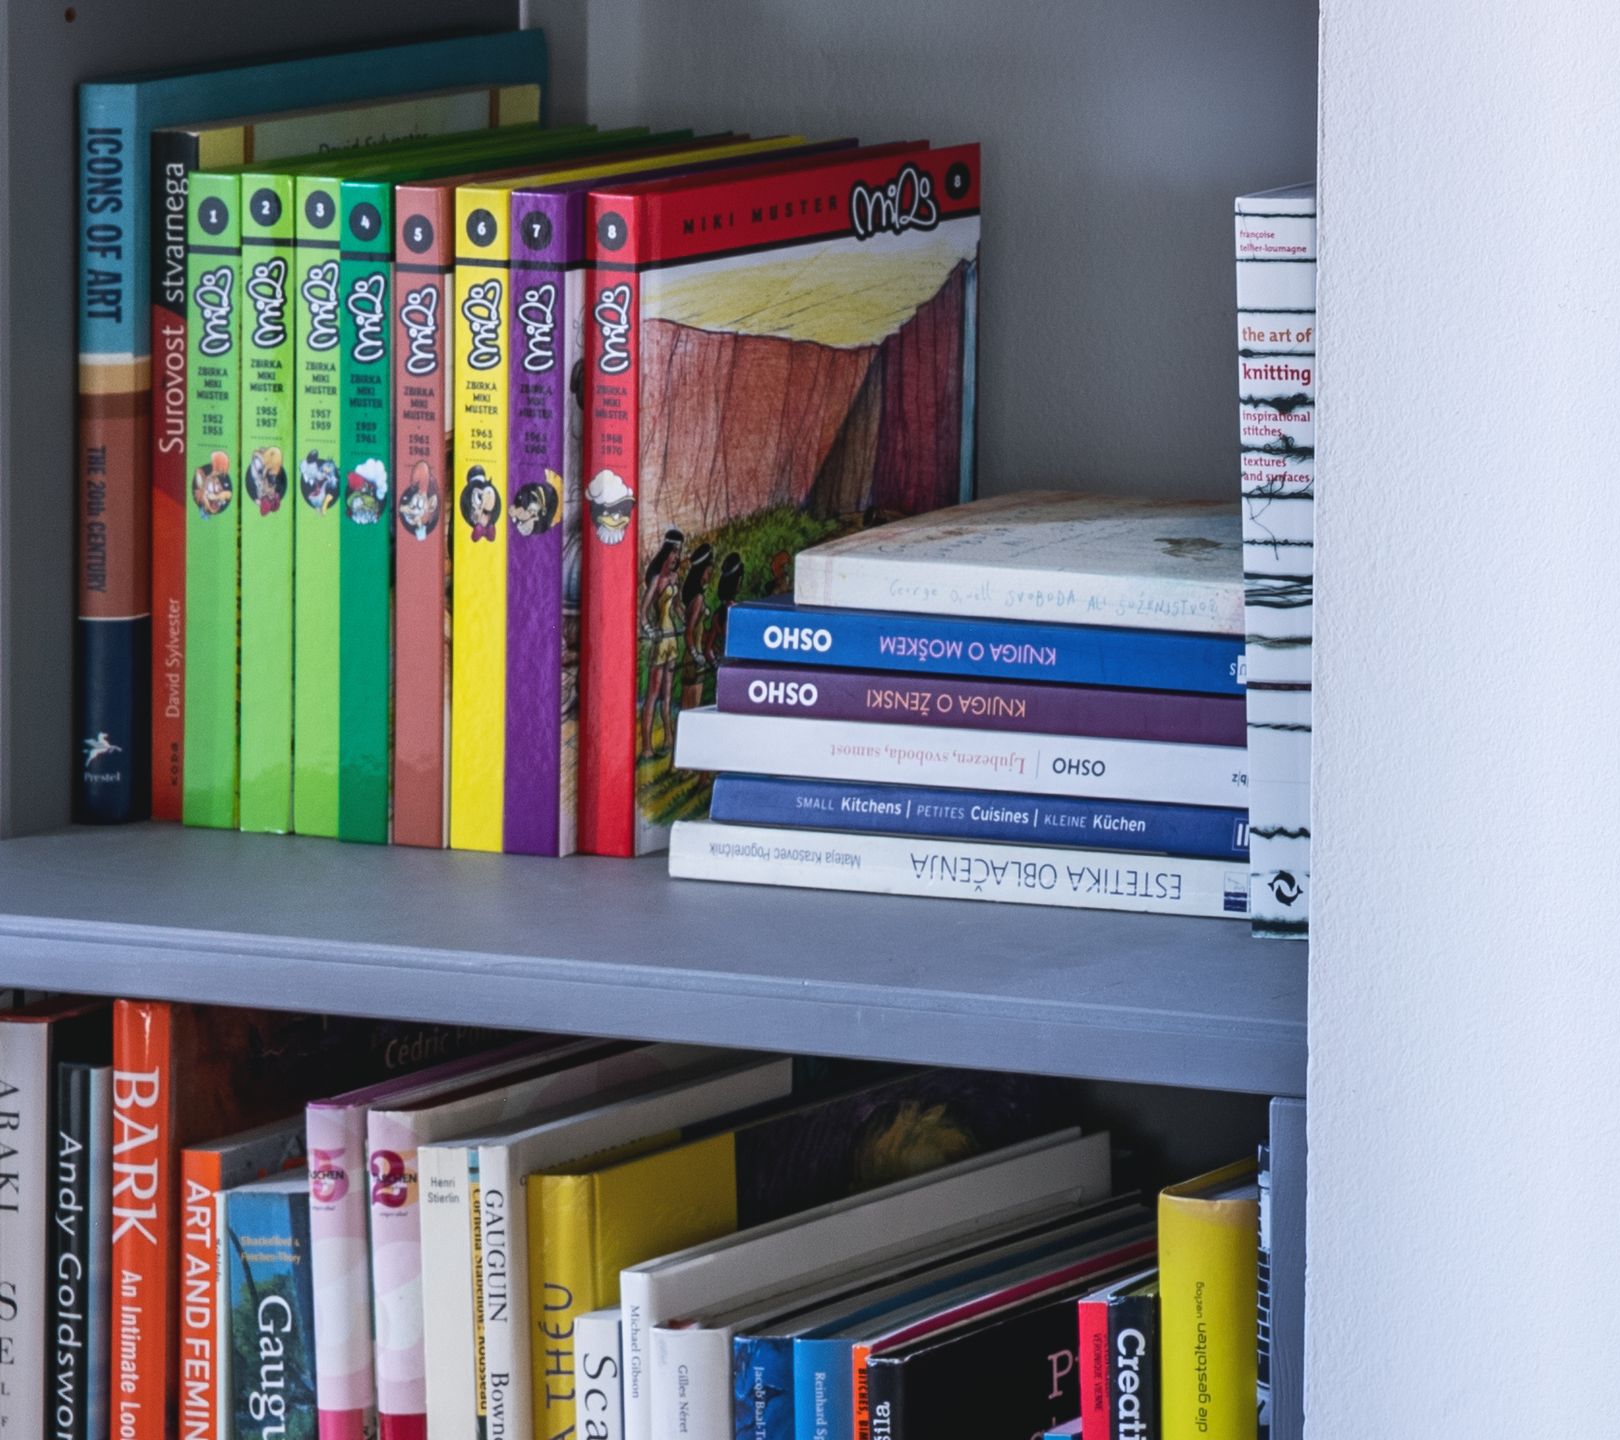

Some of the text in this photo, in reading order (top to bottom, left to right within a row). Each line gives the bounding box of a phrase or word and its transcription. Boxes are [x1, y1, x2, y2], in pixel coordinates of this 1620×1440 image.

[86, 127, 123, 326] ICONS OF ART
[1243, 327, 1311, 343] the art of
[1243, 363, 1311, 385] knitting
[763, 625, 832, 652] OSHO
[879, 635, 1058, 666] KNJIGA O MOŠKEM
[748, 680, 819, 707] OSHO
[112, 1067, 160, 1246] BARK
